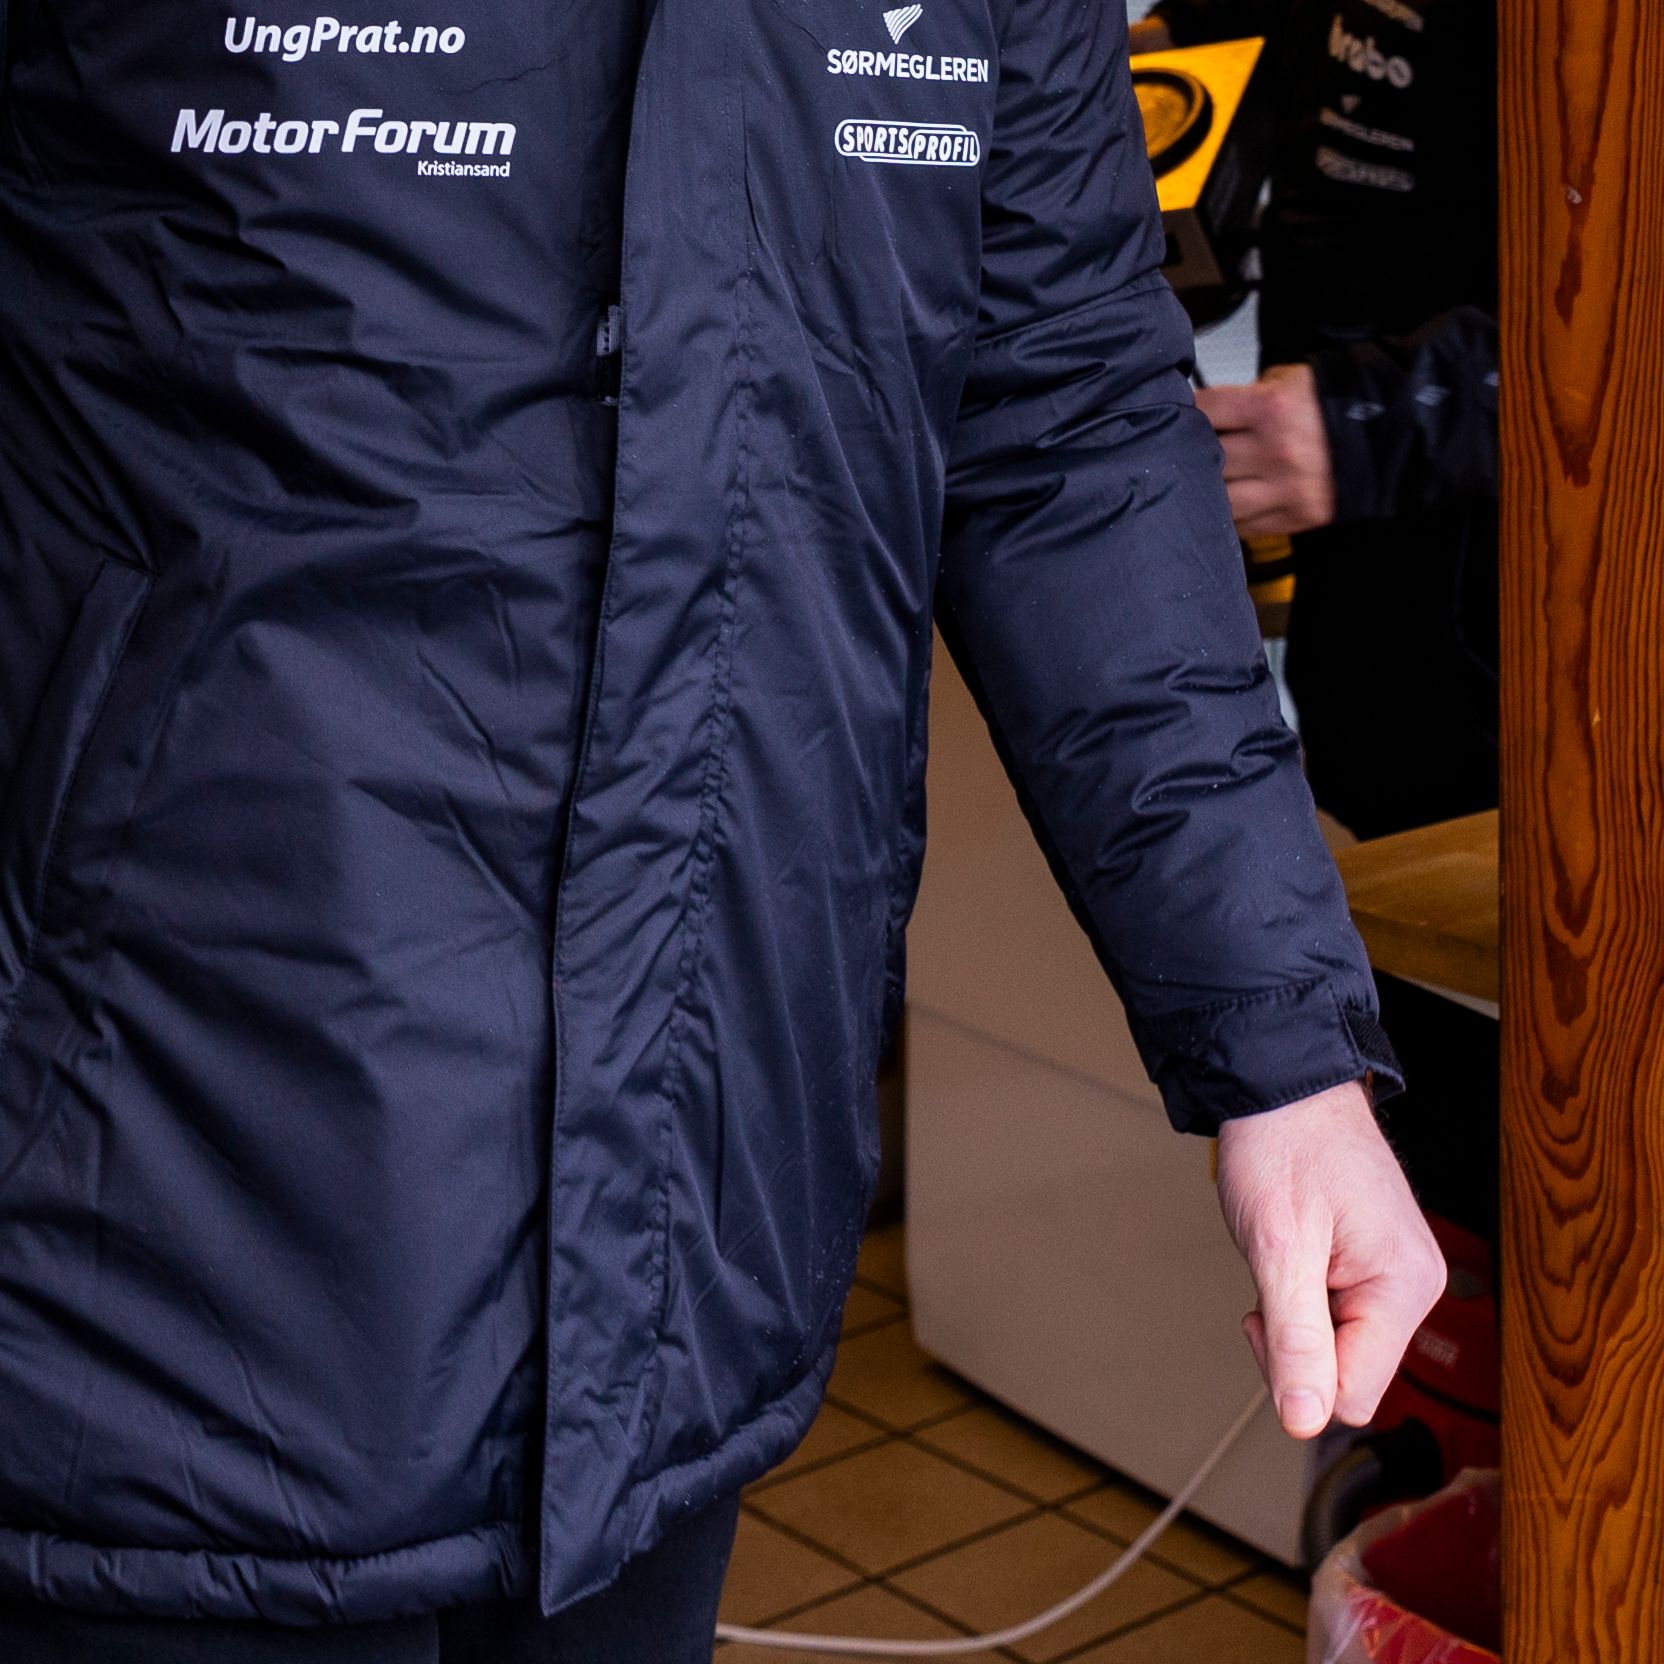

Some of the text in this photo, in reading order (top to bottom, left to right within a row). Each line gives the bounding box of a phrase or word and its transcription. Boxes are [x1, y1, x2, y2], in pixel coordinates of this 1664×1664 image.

[224, 16, 466, 63] UngPrat.no
[827, 48, 989, 83] SØRMEGLEREN
[417, 160, 511, 178] Kristiansand
